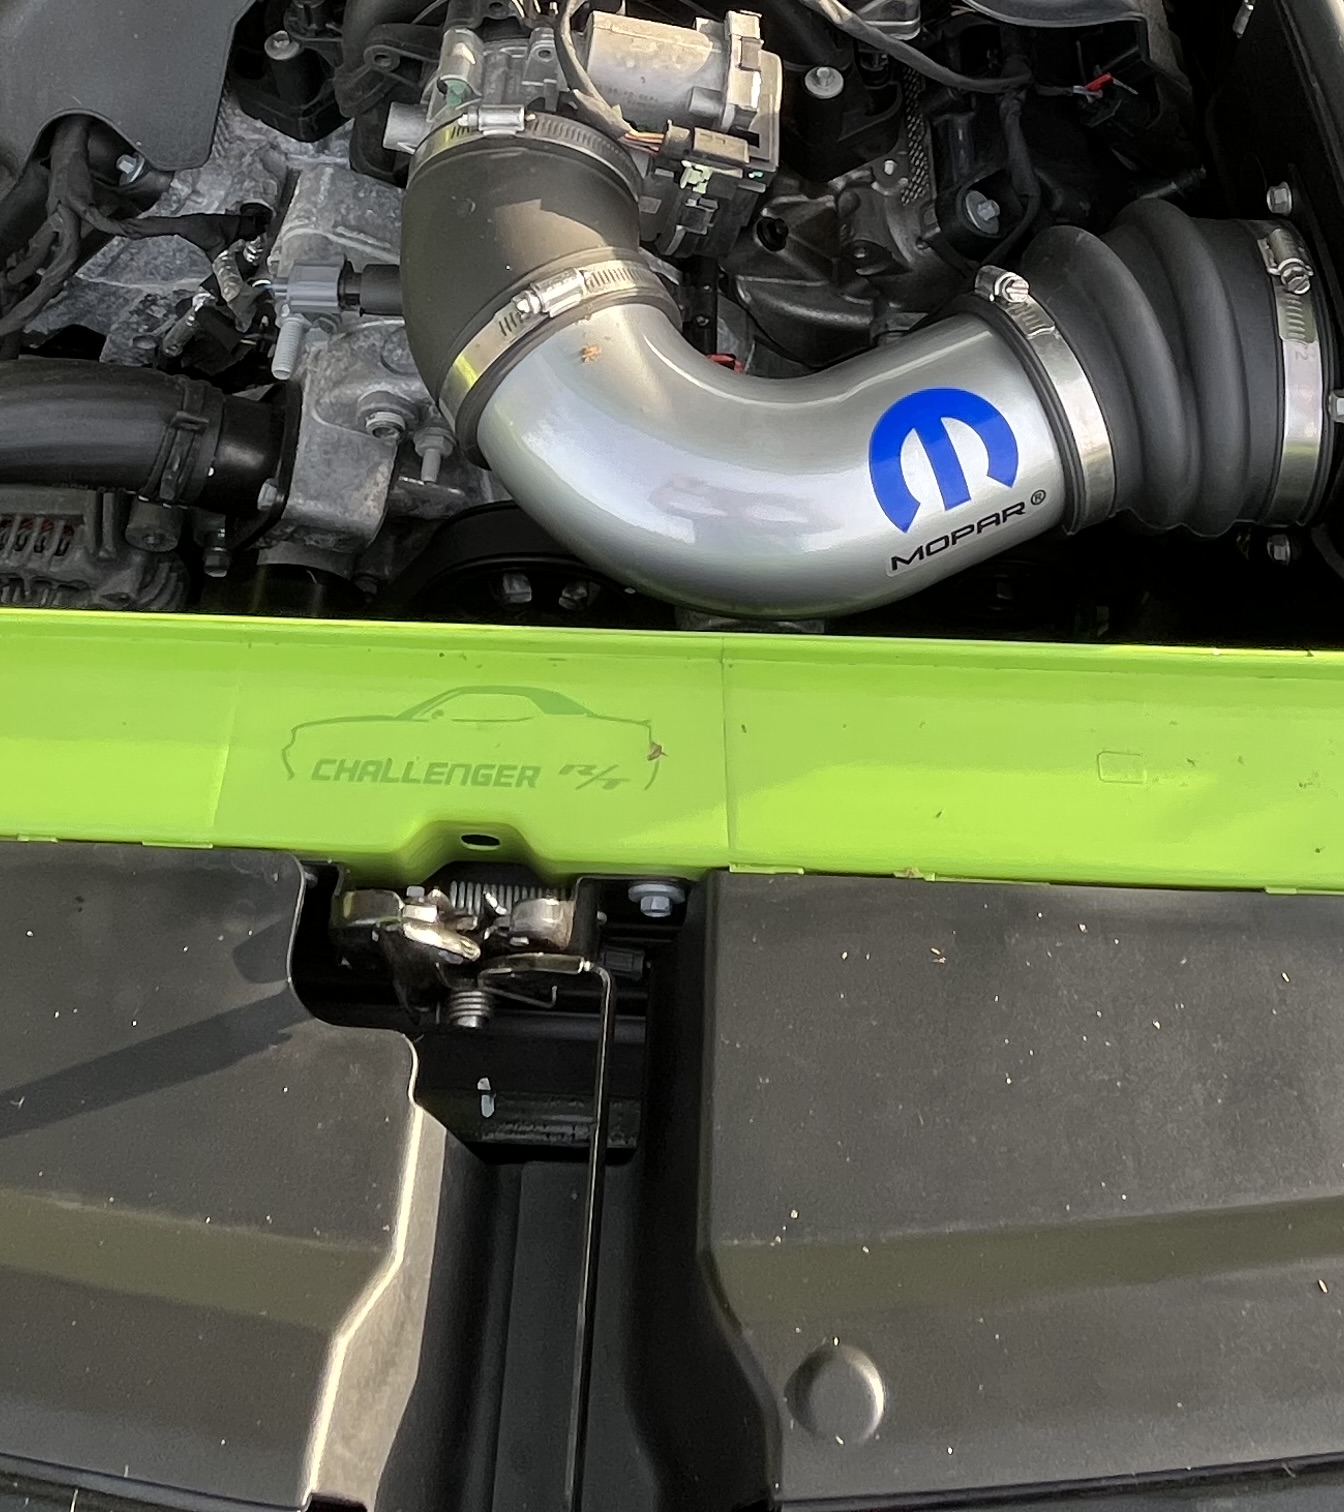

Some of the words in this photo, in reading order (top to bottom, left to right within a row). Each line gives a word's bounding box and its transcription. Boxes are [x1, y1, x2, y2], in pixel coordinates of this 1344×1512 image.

[890, 501, 1026, 572] MOPAR
[311, 756, 542, 789] CHALLENGER
[558, 764, 632, 791] R/T
